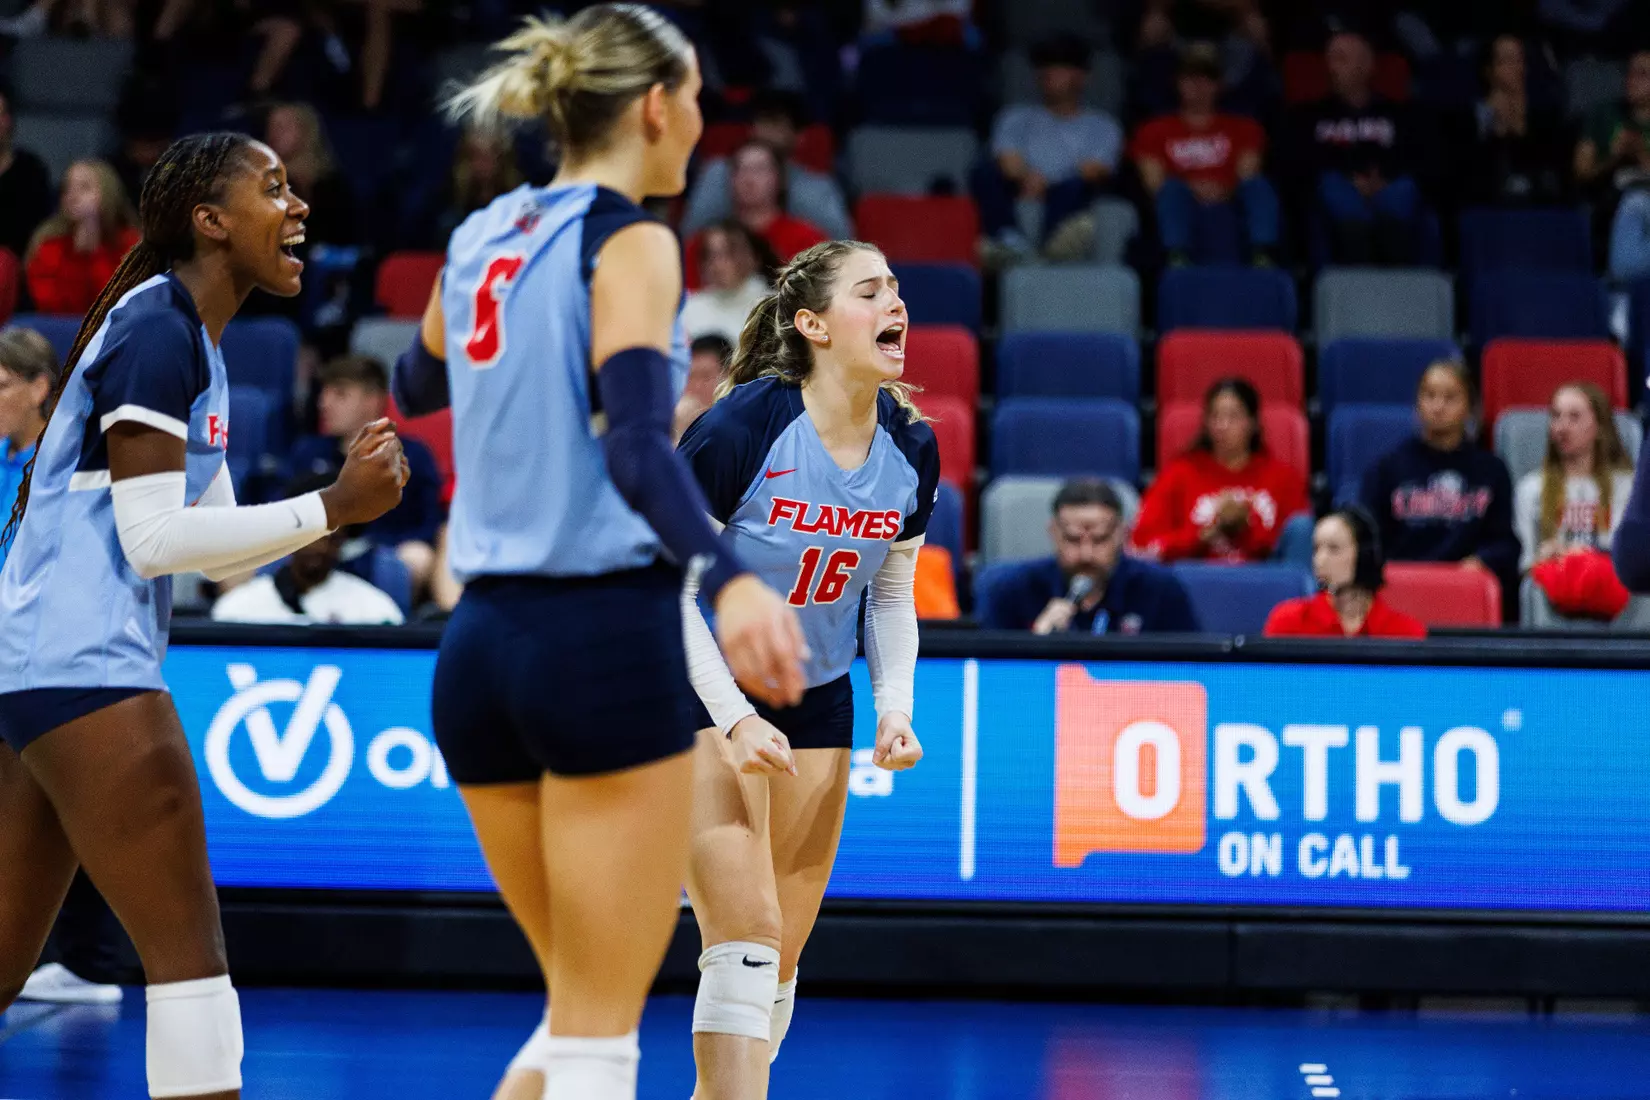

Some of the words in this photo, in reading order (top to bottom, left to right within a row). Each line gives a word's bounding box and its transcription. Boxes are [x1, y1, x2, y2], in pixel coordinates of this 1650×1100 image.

[767, 497, 901, 541] FLAMES
[786, 546, 861, 608] 16
[1114, 720, 1500, 826] ORTHO
[1218, 831, 1283, 877] ON
[1298, 832, 1411, 879] CALL
